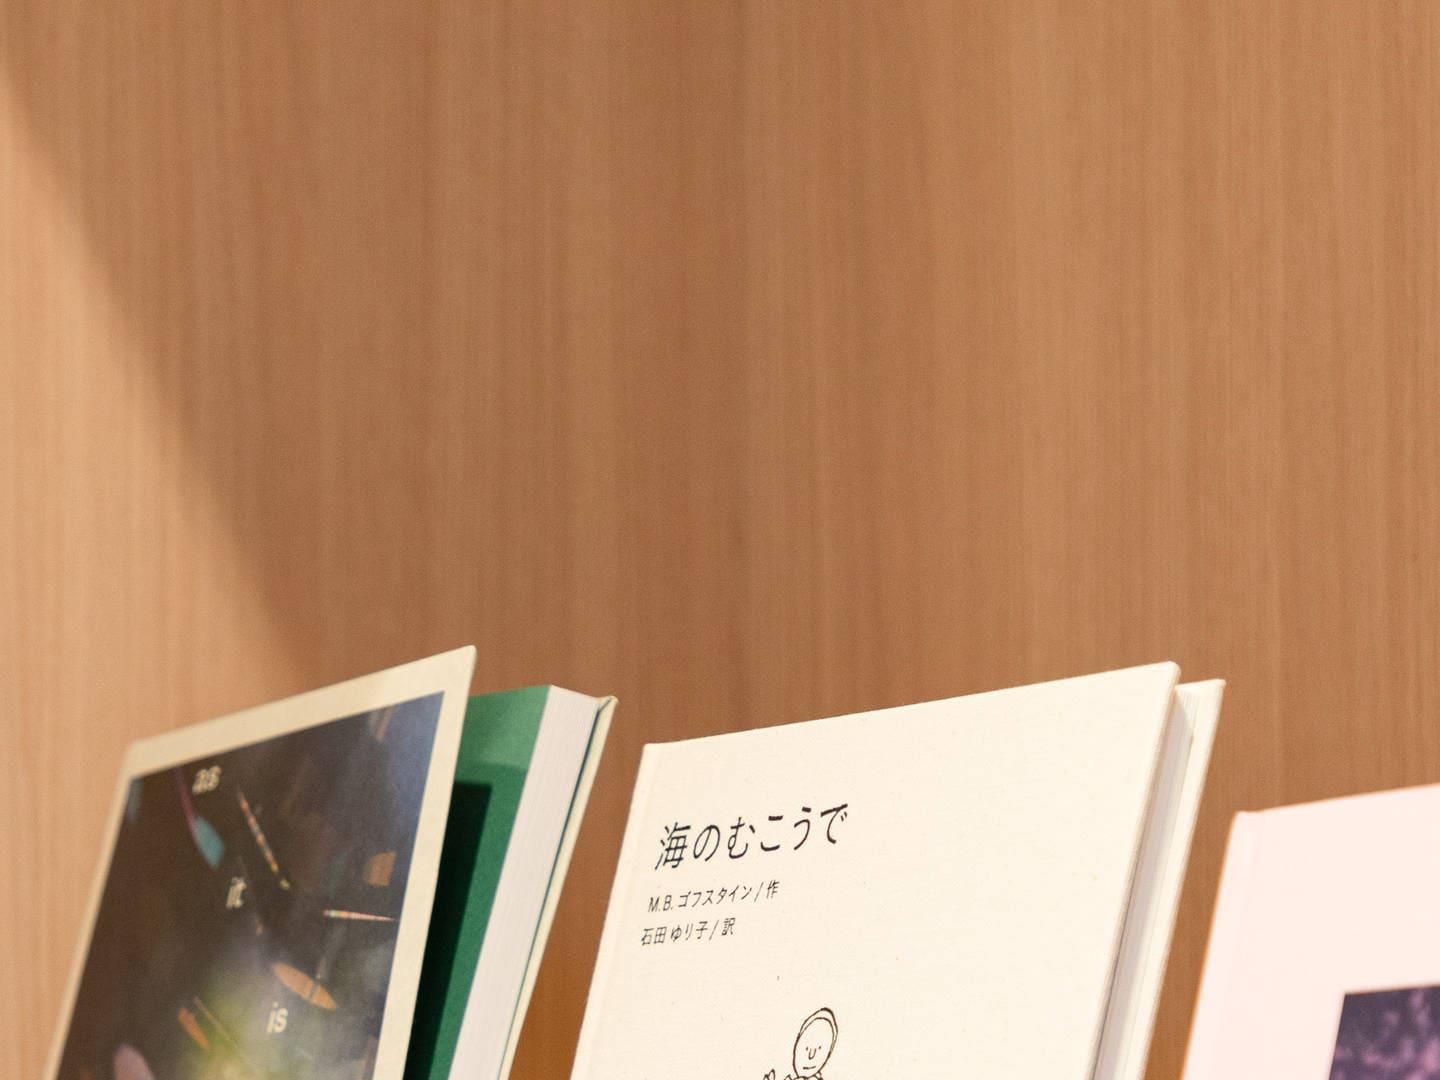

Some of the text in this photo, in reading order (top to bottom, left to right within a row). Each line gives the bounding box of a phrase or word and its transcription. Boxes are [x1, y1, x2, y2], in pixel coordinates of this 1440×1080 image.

[193, 765, 222, 795] as
[654, 803, 848, 870] 海のむこうで
[226, 876, 248, 909] it
[266, 1002, 288, 1034] is
